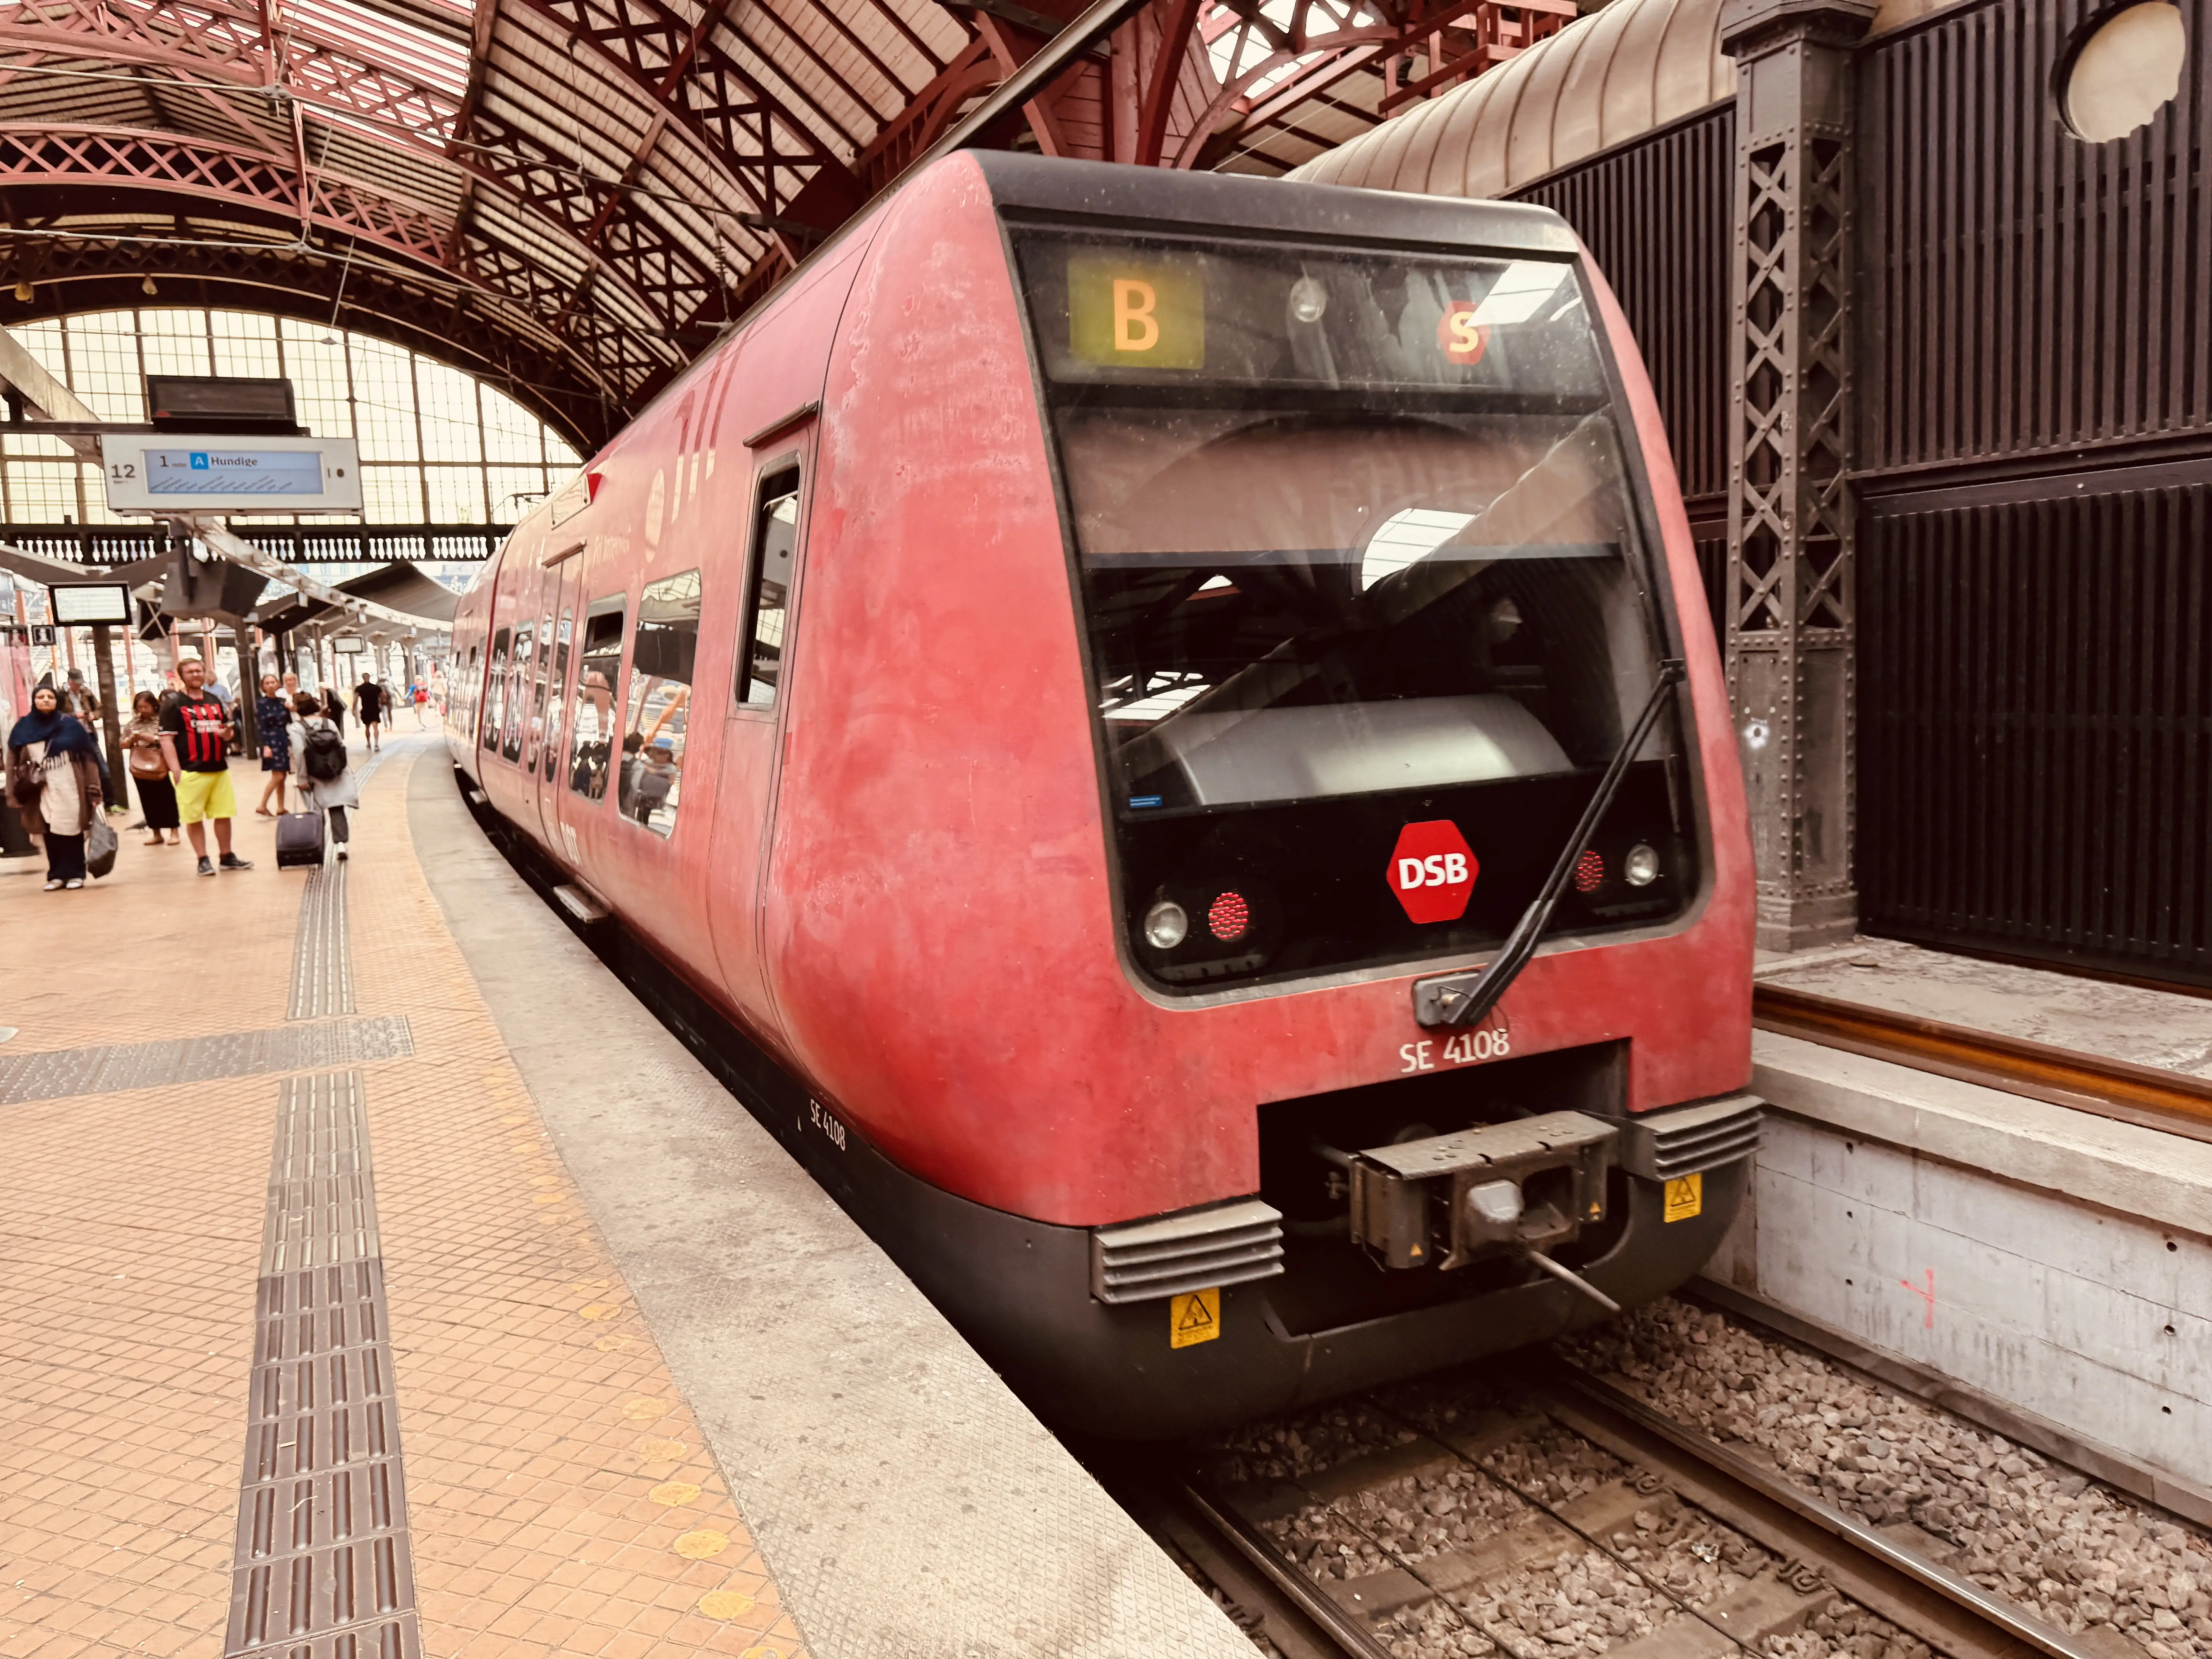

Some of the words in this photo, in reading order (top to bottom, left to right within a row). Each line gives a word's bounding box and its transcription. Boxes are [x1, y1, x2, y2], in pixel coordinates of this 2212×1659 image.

[1114, 279, 1159, 350] B
[1449, 311, 1479, 352] S
[112, 464, 136, 478] 12
[160, 455, 168, 467] 1
[195, 456, 204, 465] A
[211, 457, 258, 467] Hundige
[1398, 853, 1468, 890] DSB
[1400, 1040, 1435, 1073] SE
[1443, 1028, 1510, 1063] 4108
[811, 1099, 821, 1128] SE
[823, 1111, 845, 1151] 4108
